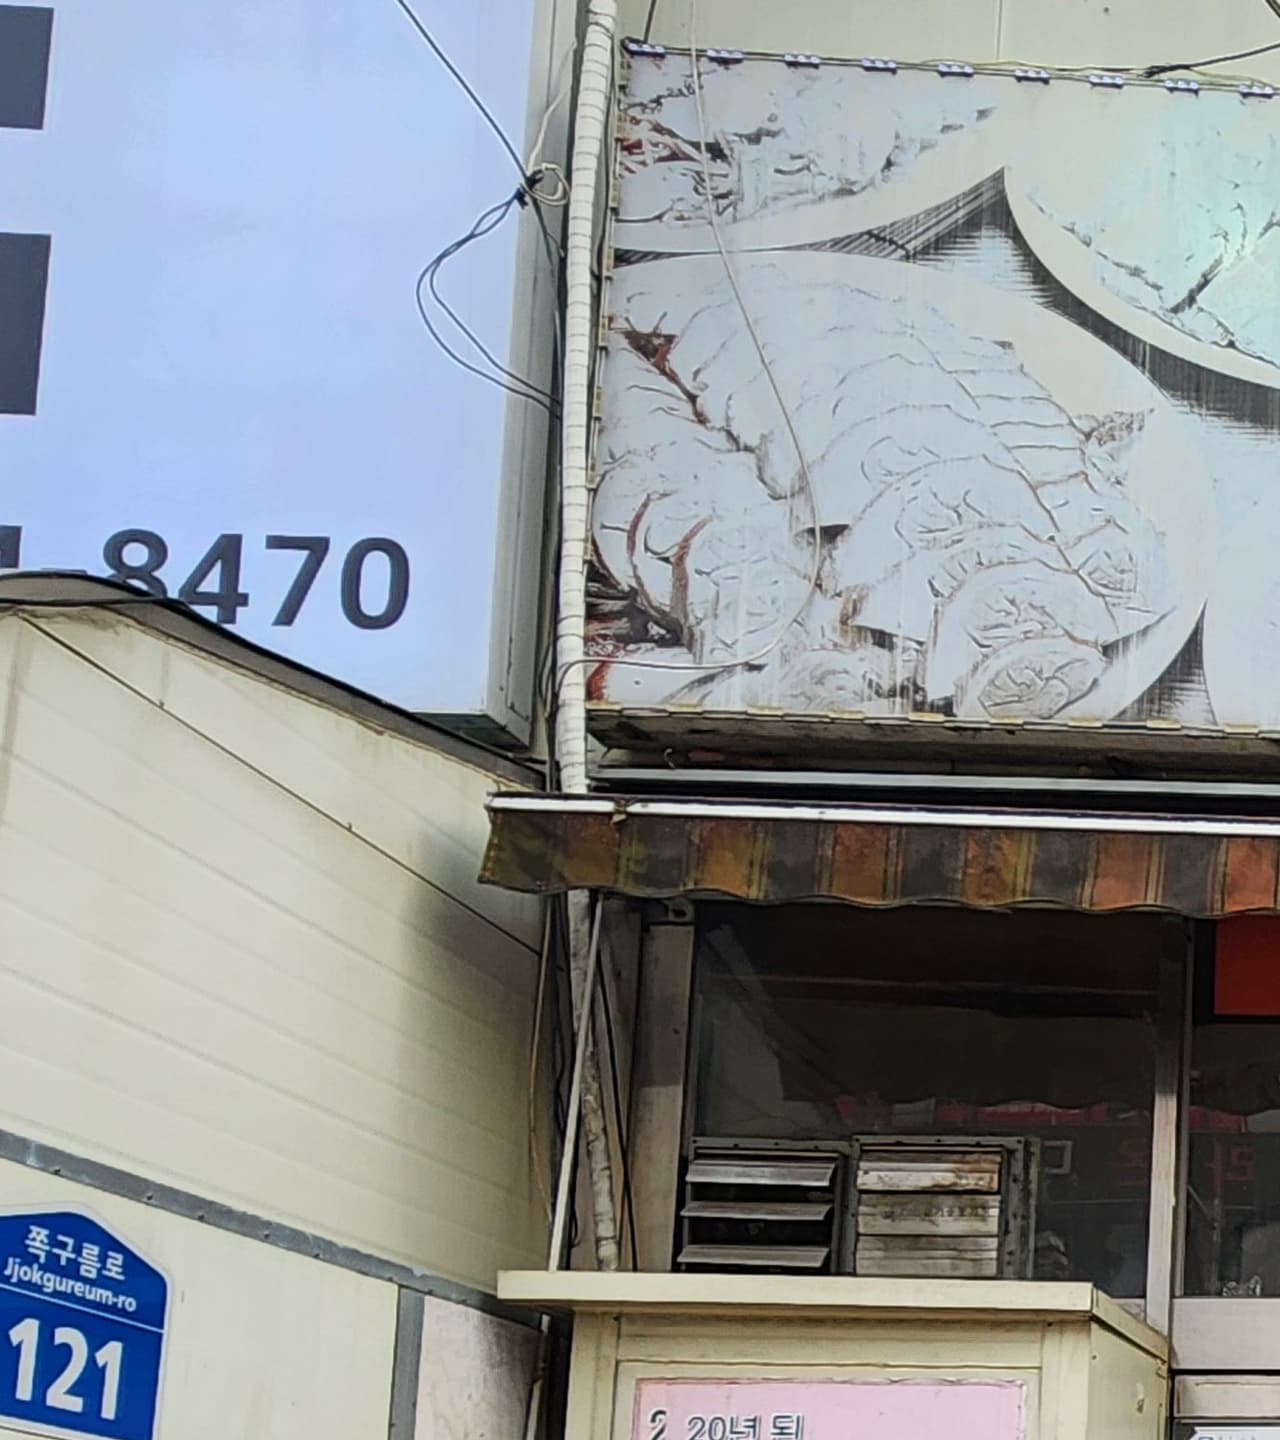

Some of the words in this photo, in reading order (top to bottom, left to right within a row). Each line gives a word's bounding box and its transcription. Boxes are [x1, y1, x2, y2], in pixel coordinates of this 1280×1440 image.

[24, 1225, 126, 1281] 쪽구름로
[4, 1257, 137, 1312] Jjokgureum-ro
[8, 1318, 123, 1420] 121
